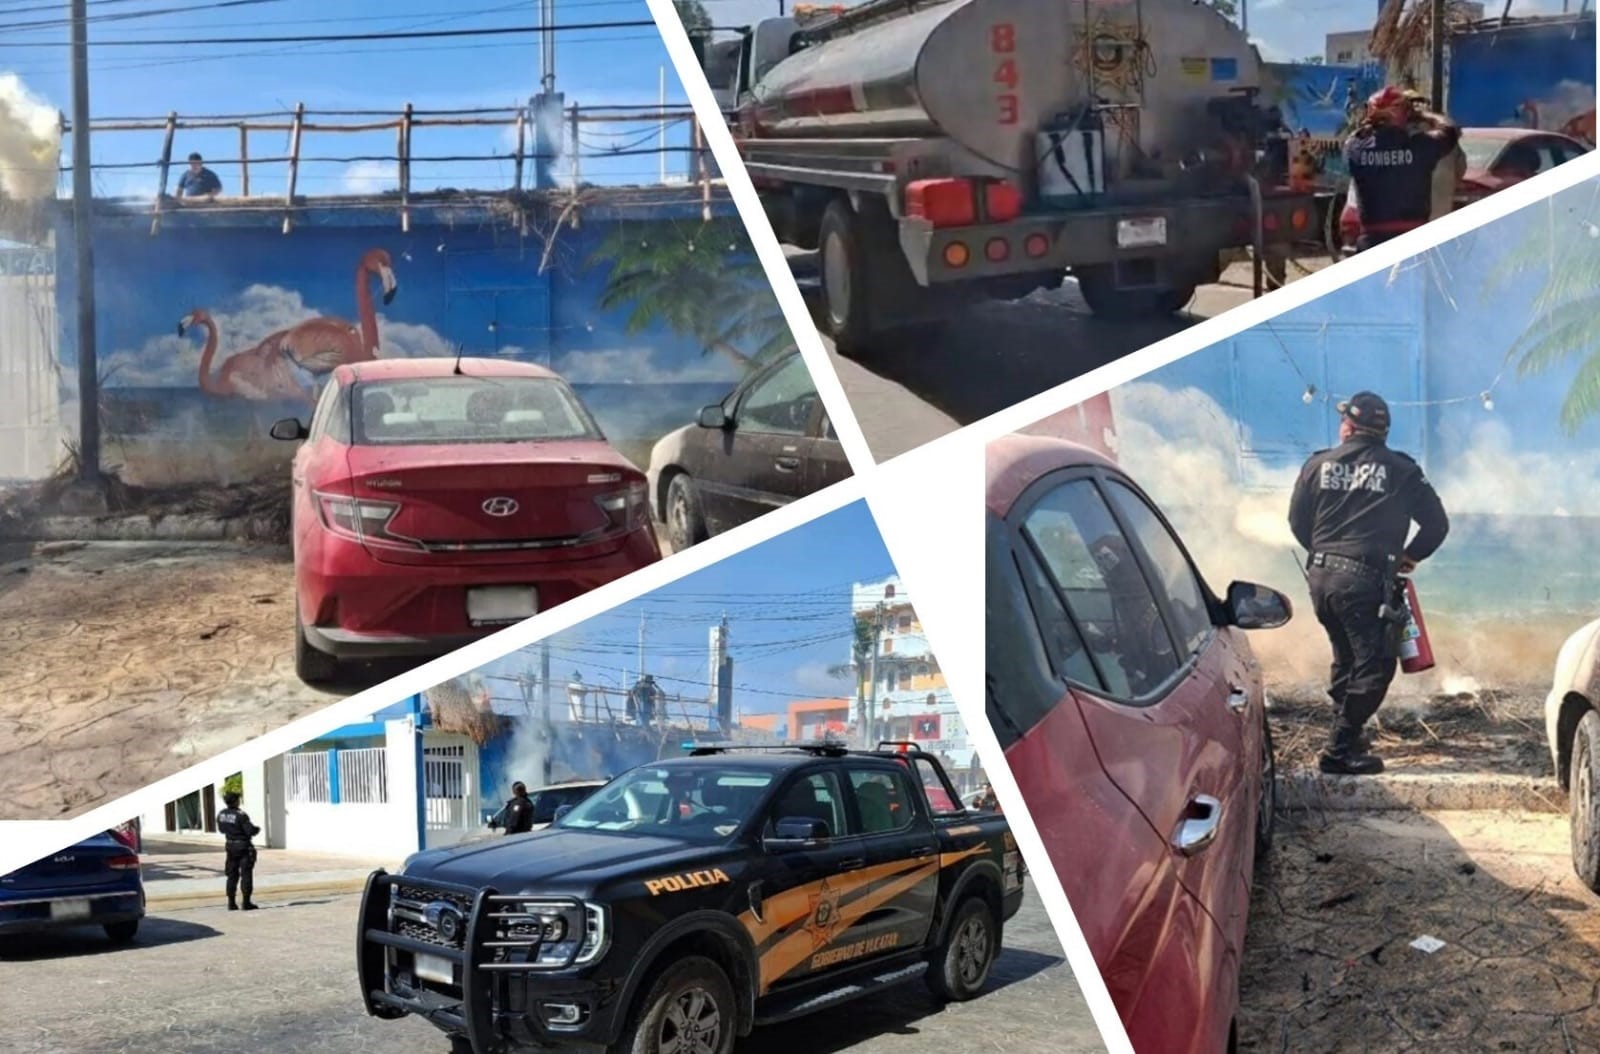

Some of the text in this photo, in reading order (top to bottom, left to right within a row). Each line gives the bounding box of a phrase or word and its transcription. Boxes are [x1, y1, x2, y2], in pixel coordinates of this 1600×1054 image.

[991, 23, 1019, 125] 843
[1360, 149, 1413, 166] BOMBERO
[644, 868, 730, 896] POLICIA
